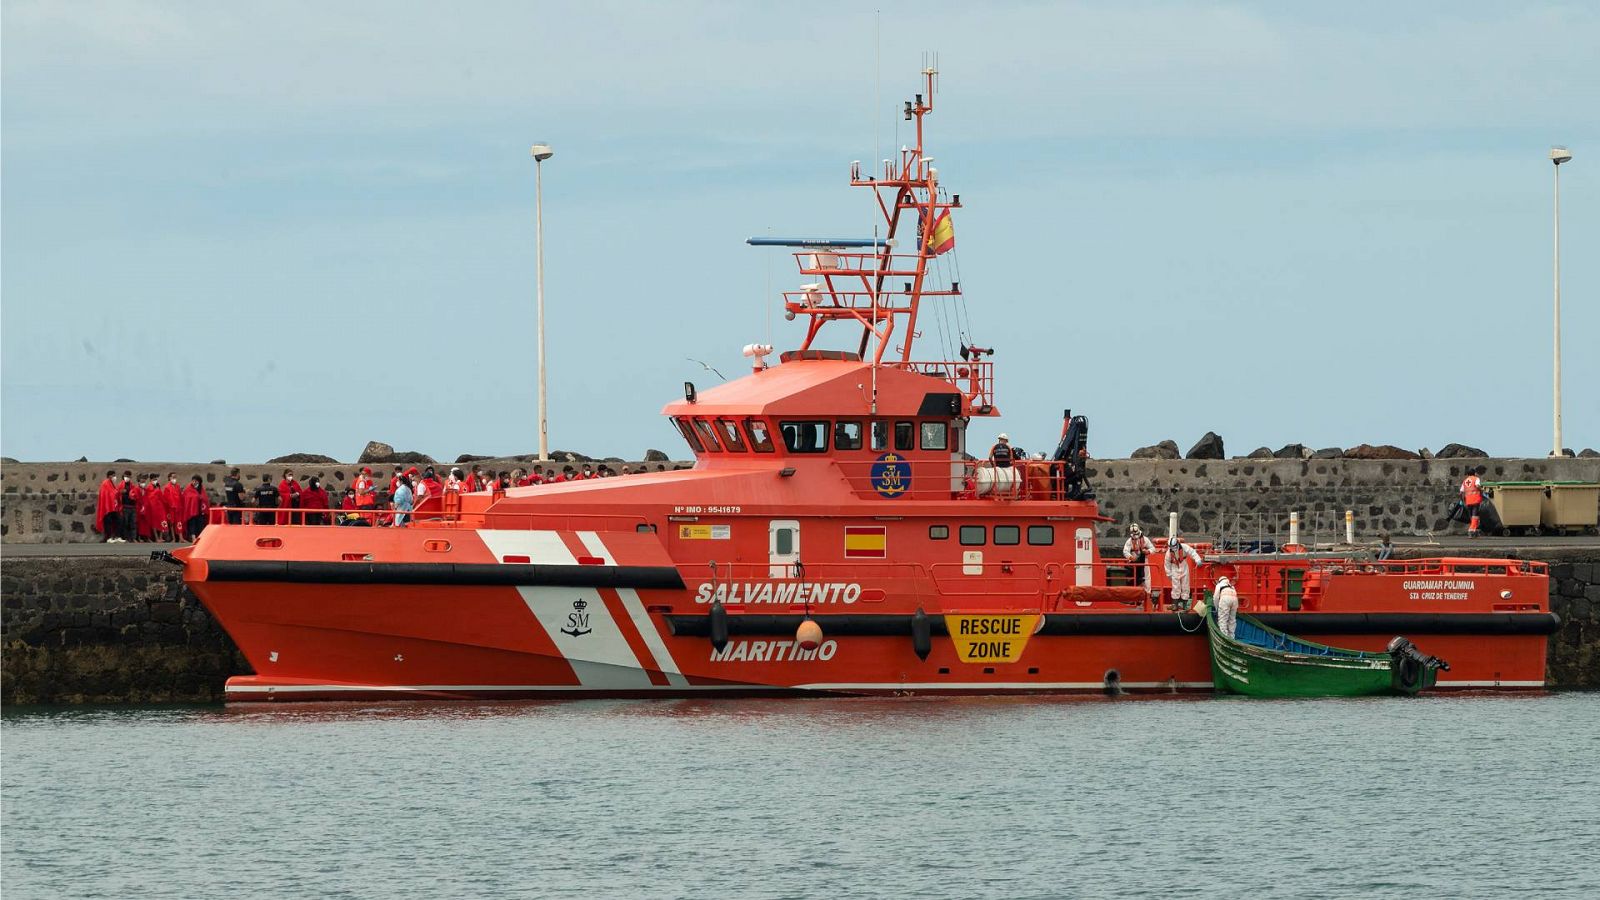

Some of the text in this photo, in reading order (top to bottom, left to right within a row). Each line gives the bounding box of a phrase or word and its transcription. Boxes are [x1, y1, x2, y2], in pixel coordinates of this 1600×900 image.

[1403, 580, 1475, 590] GUARDAMAR POLIMNIA
[695, 583, 861, 604] SALVAMENTO
[1421, 592, 1435, 600] CRUZ
[1436, 592, 1443, 600] DE
[567, 613, 590, 628] SM
[960, 618, 1021, 635] RESCUE
[967, 641, 1011, 658] ZONE
